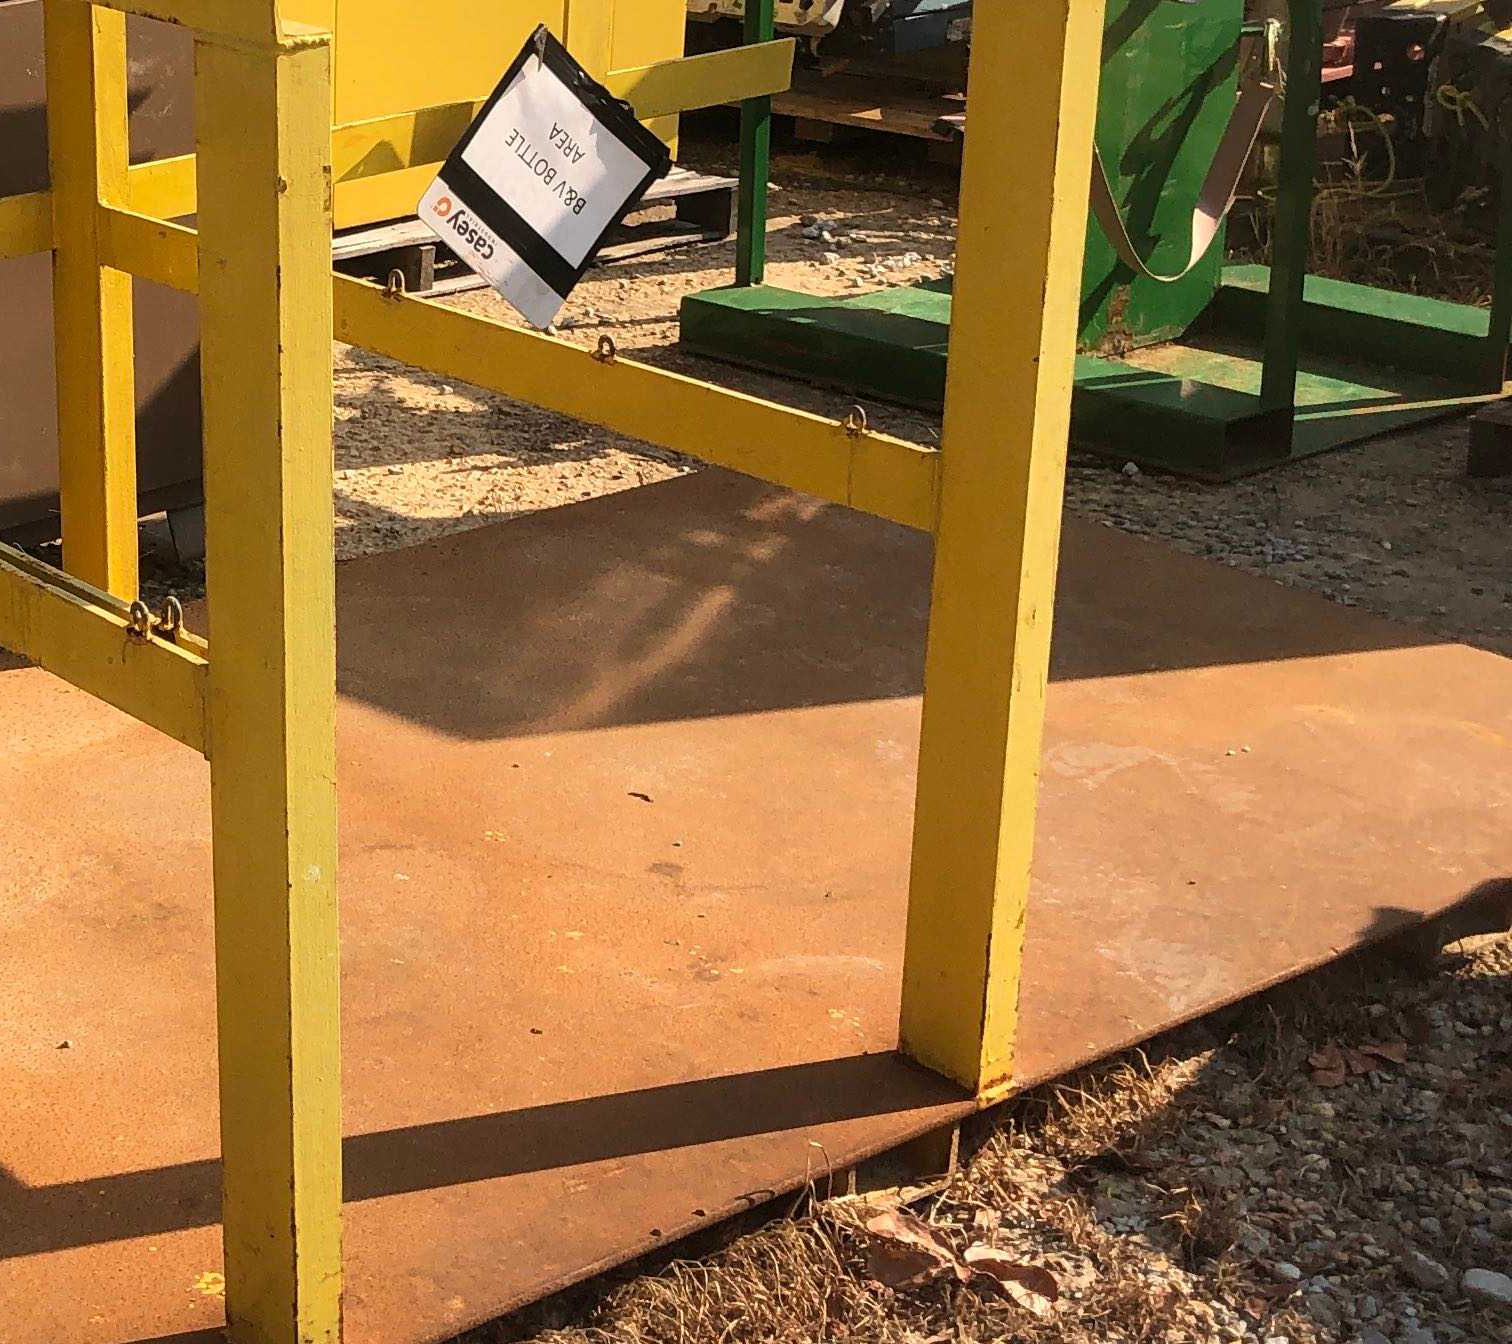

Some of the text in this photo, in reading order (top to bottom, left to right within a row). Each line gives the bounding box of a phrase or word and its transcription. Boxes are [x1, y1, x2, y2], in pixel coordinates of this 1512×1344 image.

[549, 122, 586, 164] AREA
[505, 127, 586, 216] B&V BOTTLE
[446, 209, 494, 260] casey
